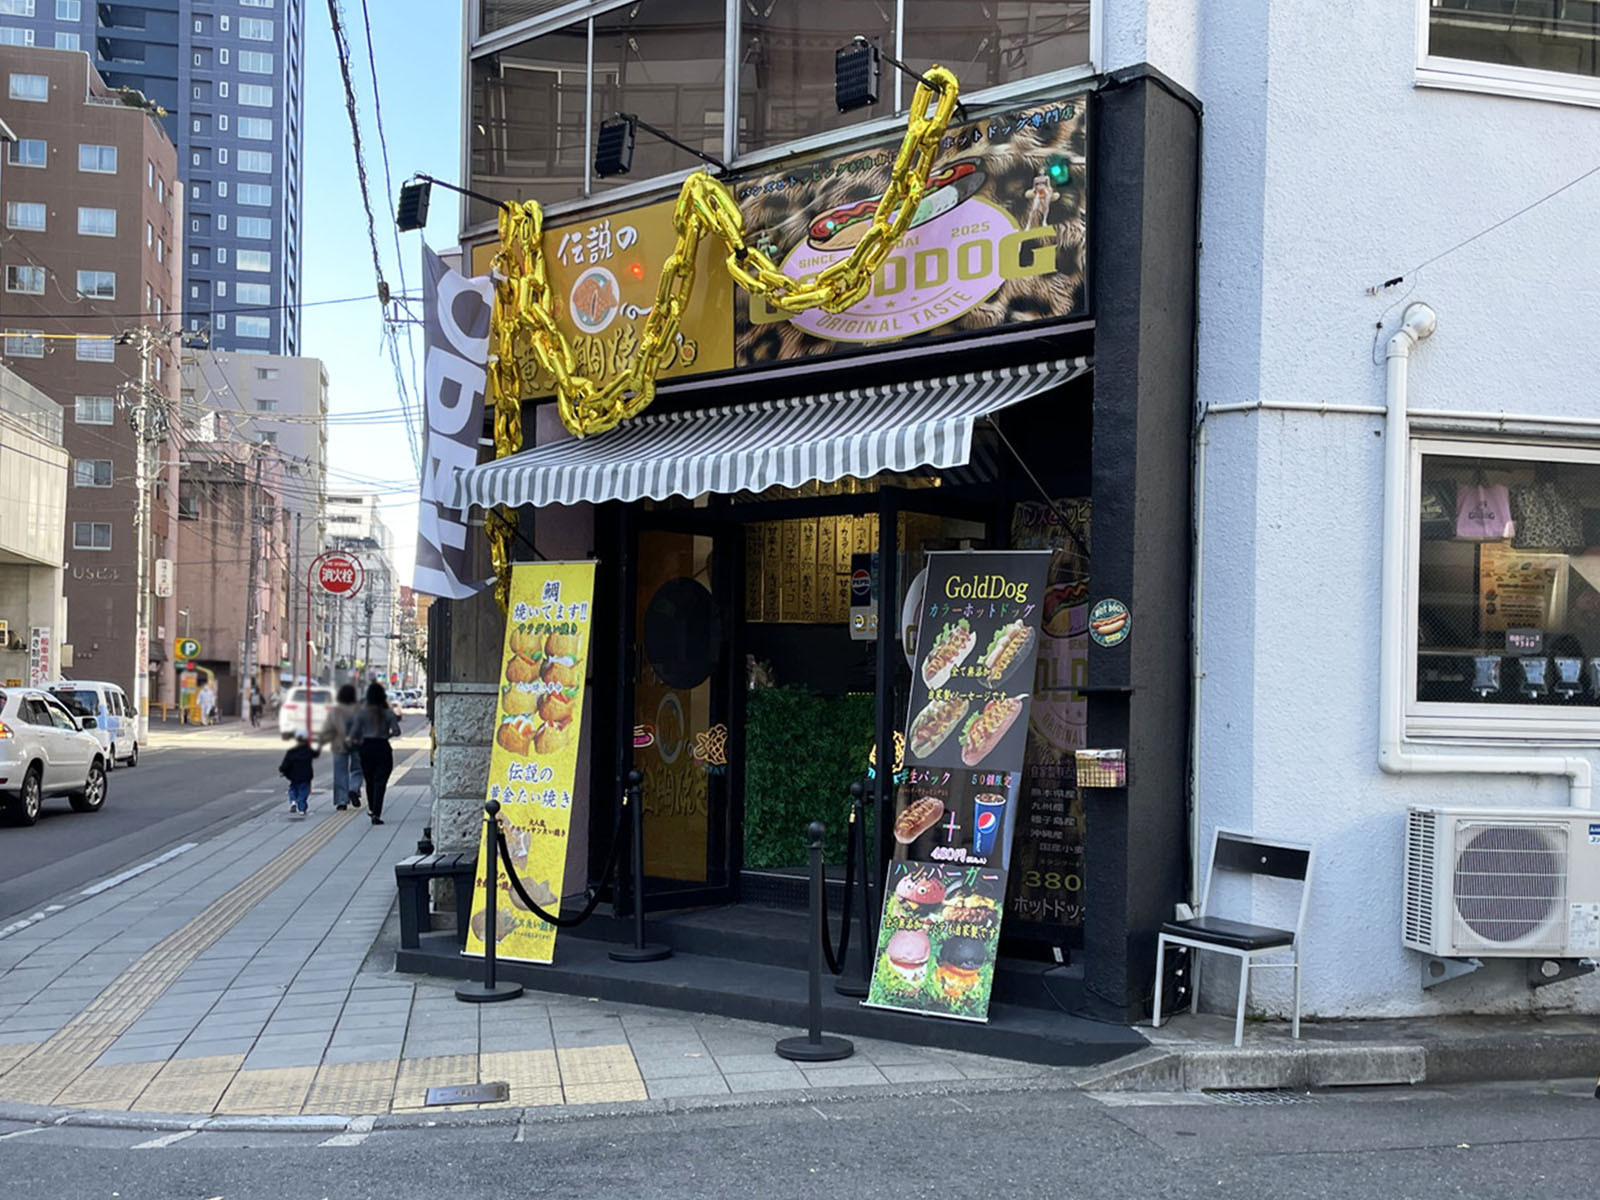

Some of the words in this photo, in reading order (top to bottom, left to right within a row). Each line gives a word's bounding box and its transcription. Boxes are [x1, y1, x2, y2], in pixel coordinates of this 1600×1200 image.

[557, 219, 637, 266] 伝説の
[798, 254, 835, 268] SINCE
[951, 221, 990, 238] 2025
[815, 313, 904, 334] ORIGINAL
[908, 289, 974, 325] TASTE
[321, 567, 354, 583] 消火栓
[541, 581, 561, 603] 鯛
[945, 575, 1029, 603] GoldDog
[928, 603, 1036, 618] カラーホットドッグ
[185, 642, 196, 656] P
[508, 763, 553, 783] 伝説の
[489, 786, 571, 809] 黄金たい焼き
[895, 862, 999, 887] ハンバーガー
[1024, 870, 1086, 892] 380
